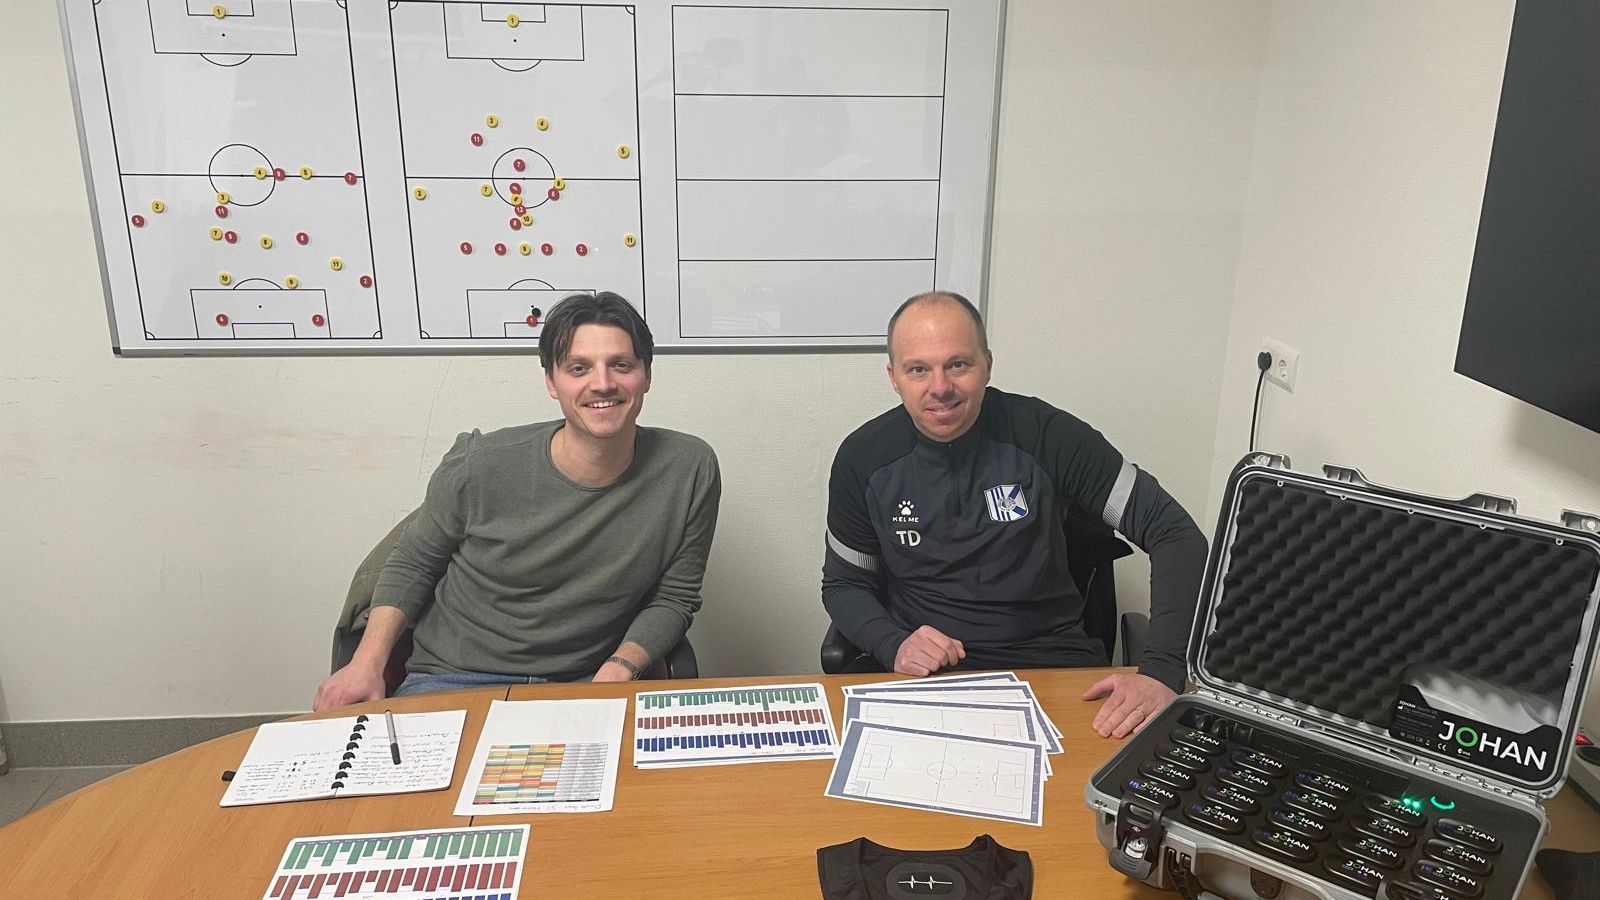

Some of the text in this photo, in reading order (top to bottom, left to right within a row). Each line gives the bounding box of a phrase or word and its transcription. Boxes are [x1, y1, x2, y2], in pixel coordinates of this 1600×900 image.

[896, 530, 921, 547] TD
[1188, 731, 1220, 746] JOHAN
[1438, 720, 1548, 771] JOHAN
[1173, 748, 1205, 763] JOHAN
[1249, 753, 1283, 769] JOHAN
[1157, 765, 1190, 780] JOHAN
[1235, 770, 1269, 786] JOHAN
[1140, 782, 1174, 799] JOHAN
[1314, 776, 1350, 792] JOHAN
[1220, 788, 1255, 804] JOHAN
[1301, 794, 1337, 811] JOHAN
[1204, 806, 1239, 823] JOHAN
[1384, 800, 1420, 817] JOHAN
[1287, 813, 1324, 830] JOHAN
[1371, 819, 1409, 837] JOHAN
[1272, 832, 1310, 851] JOHAN
[1457, 825, 1495, 842] JOHAN
[1359, 839, 1398, 858] JOHAN
[1446, 846, 1486, 864] JOHAN
[1345, 860, 1384, 879] JOHAN
[1436, 867, 1476, 886] JOHAN
